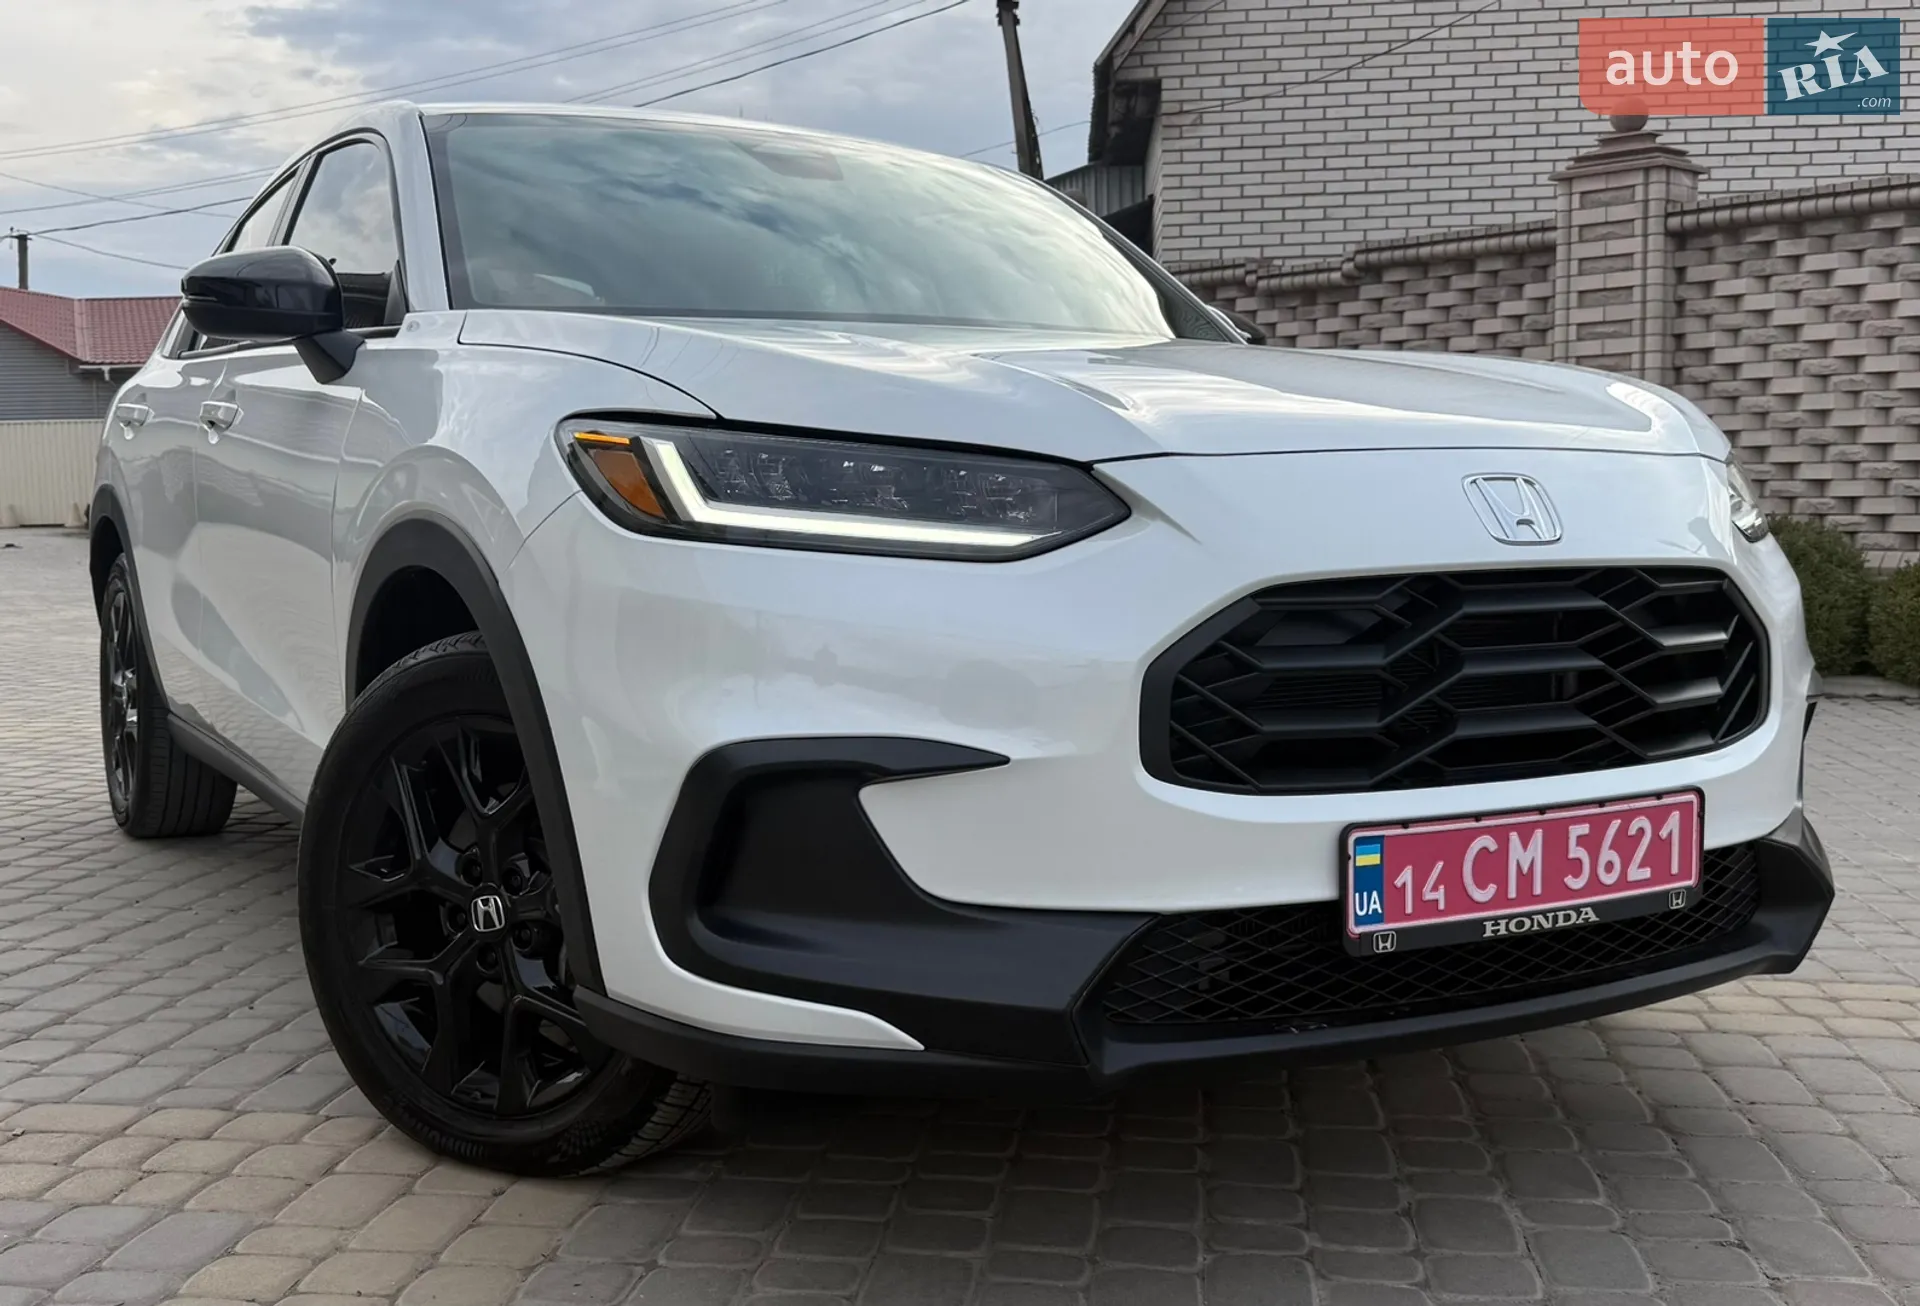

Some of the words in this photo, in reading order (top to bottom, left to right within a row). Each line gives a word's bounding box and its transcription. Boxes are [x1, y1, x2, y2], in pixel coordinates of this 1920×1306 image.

[1393, 861, 1445, 914] 14
[1462, 829, 1543, 903] CM
[1563, 811, 1681, 890] 5621
[1355, 891, 1382, 916] UA
[1482, 907, 1599, 938] HONDA
